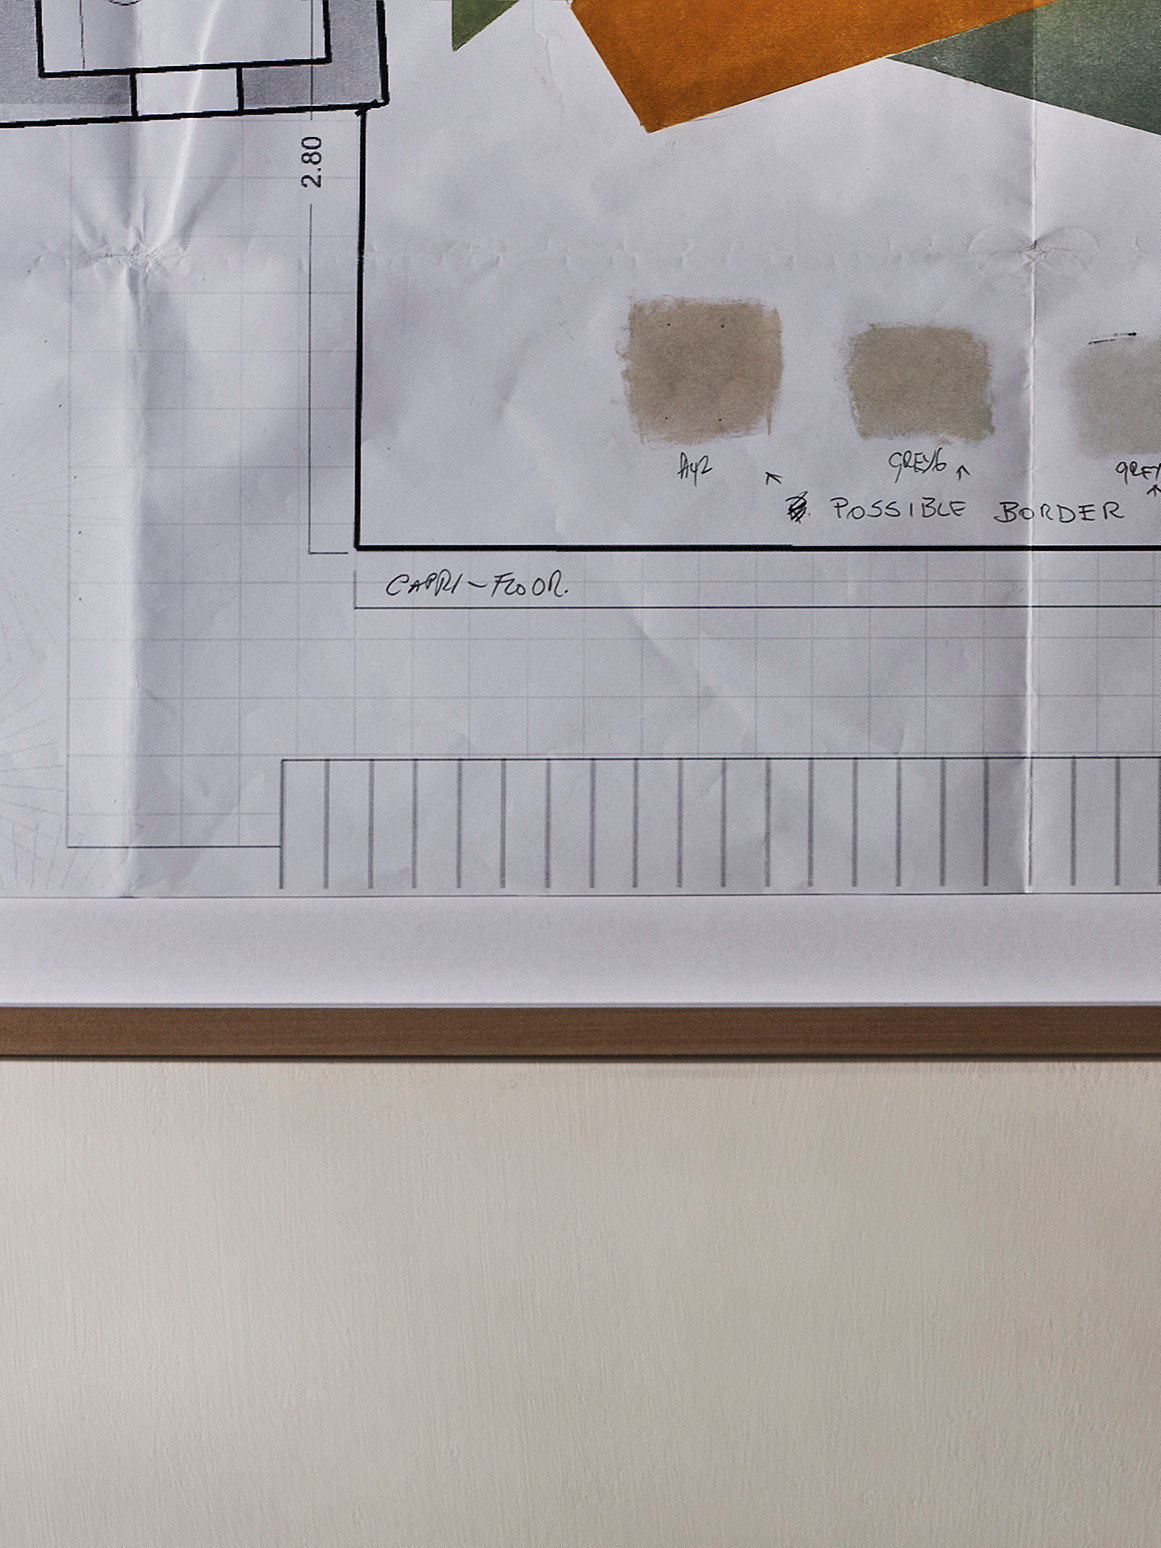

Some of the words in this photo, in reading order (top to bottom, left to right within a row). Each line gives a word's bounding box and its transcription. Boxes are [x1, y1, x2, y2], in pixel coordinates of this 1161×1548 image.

[301, 136, 322, 188] 2.80
[830, 496, 967, 521] POSSIBLE
[993, 500, 1125, 524] BORDER
